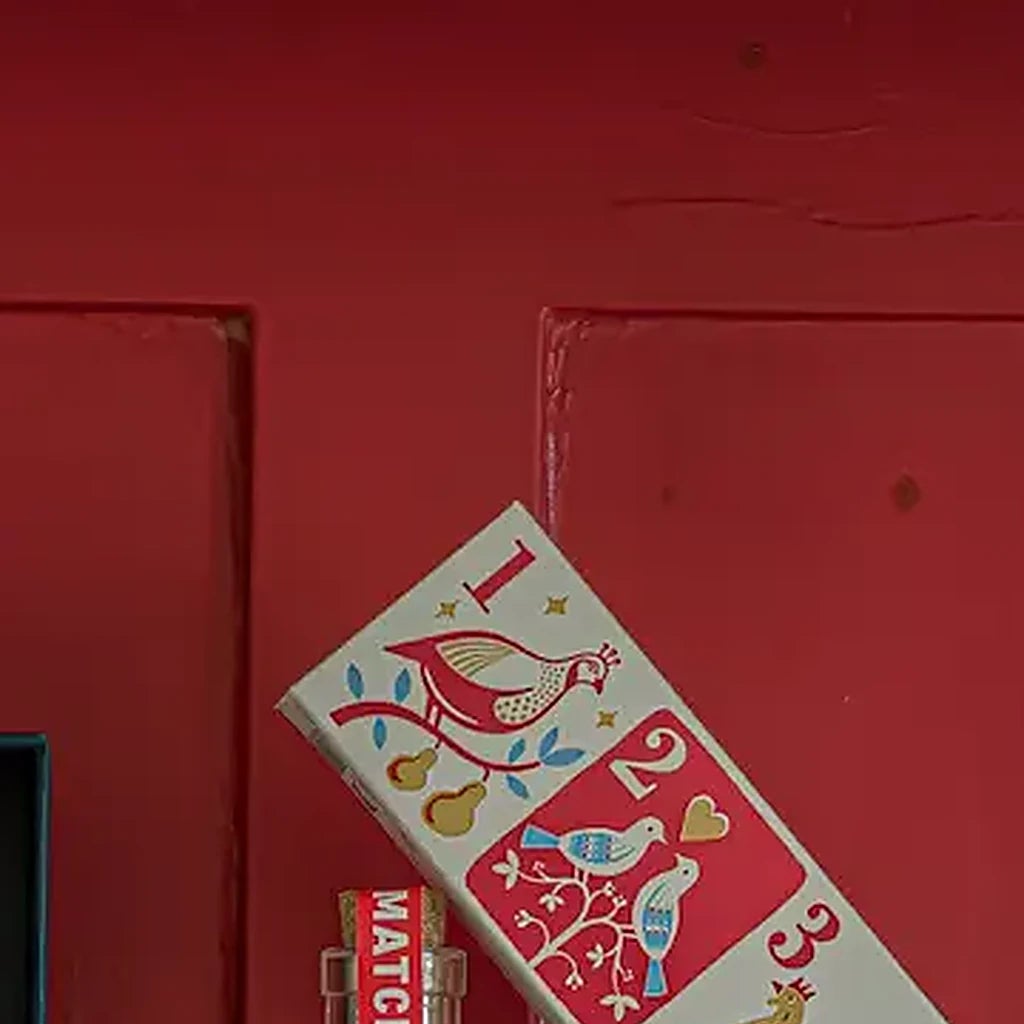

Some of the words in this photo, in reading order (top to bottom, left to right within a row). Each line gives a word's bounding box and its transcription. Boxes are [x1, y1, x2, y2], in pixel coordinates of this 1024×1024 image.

[462, 539, 536, 614] 1
[608, 728, 687, 801] 2
[767, 903, 841, 969] 3
